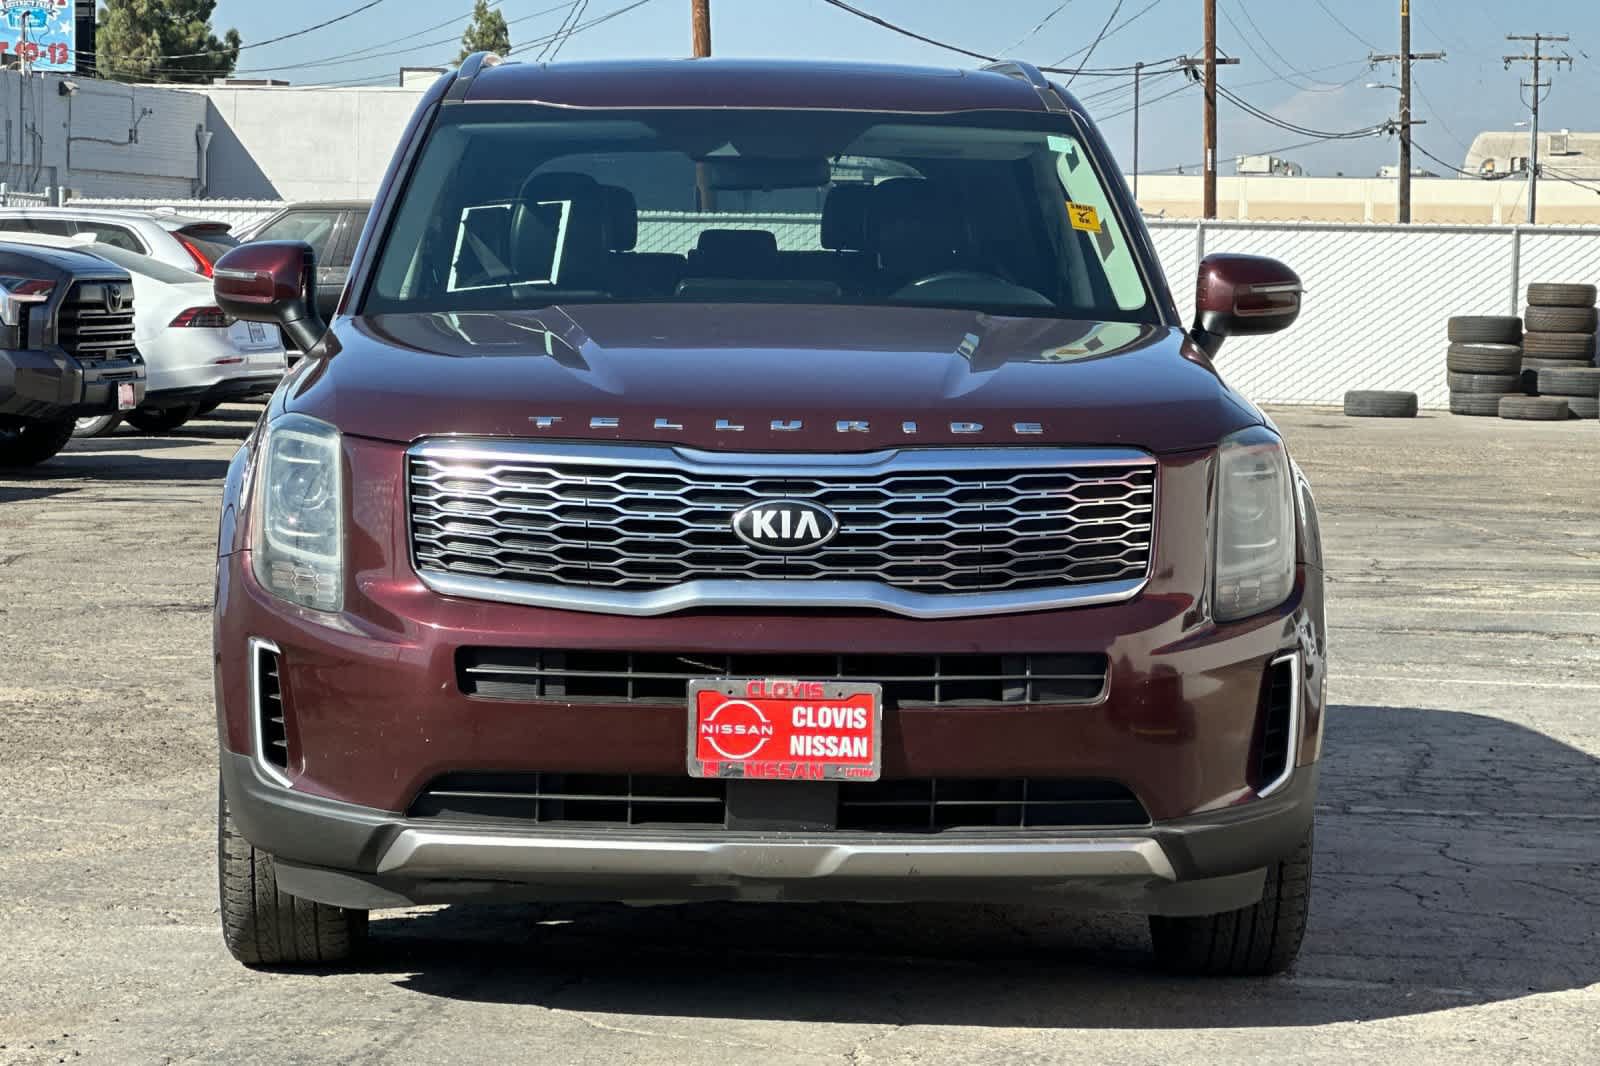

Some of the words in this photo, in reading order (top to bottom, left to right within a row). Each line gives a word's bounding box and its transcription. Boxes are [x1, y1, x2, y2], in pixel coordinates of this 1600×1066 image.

[528, 416, 1044, 434] TELLURIDE
[752, 510, 822, 539] KIA
[746, 680, 824, 698] CLOVIS
[792, 706, 867, 729] CLOVIS
[701, 724, 773, 735] NISSAN
[790, 735, 868, 758] NISSAN
[744, 763, 824, 780] NISSAN
